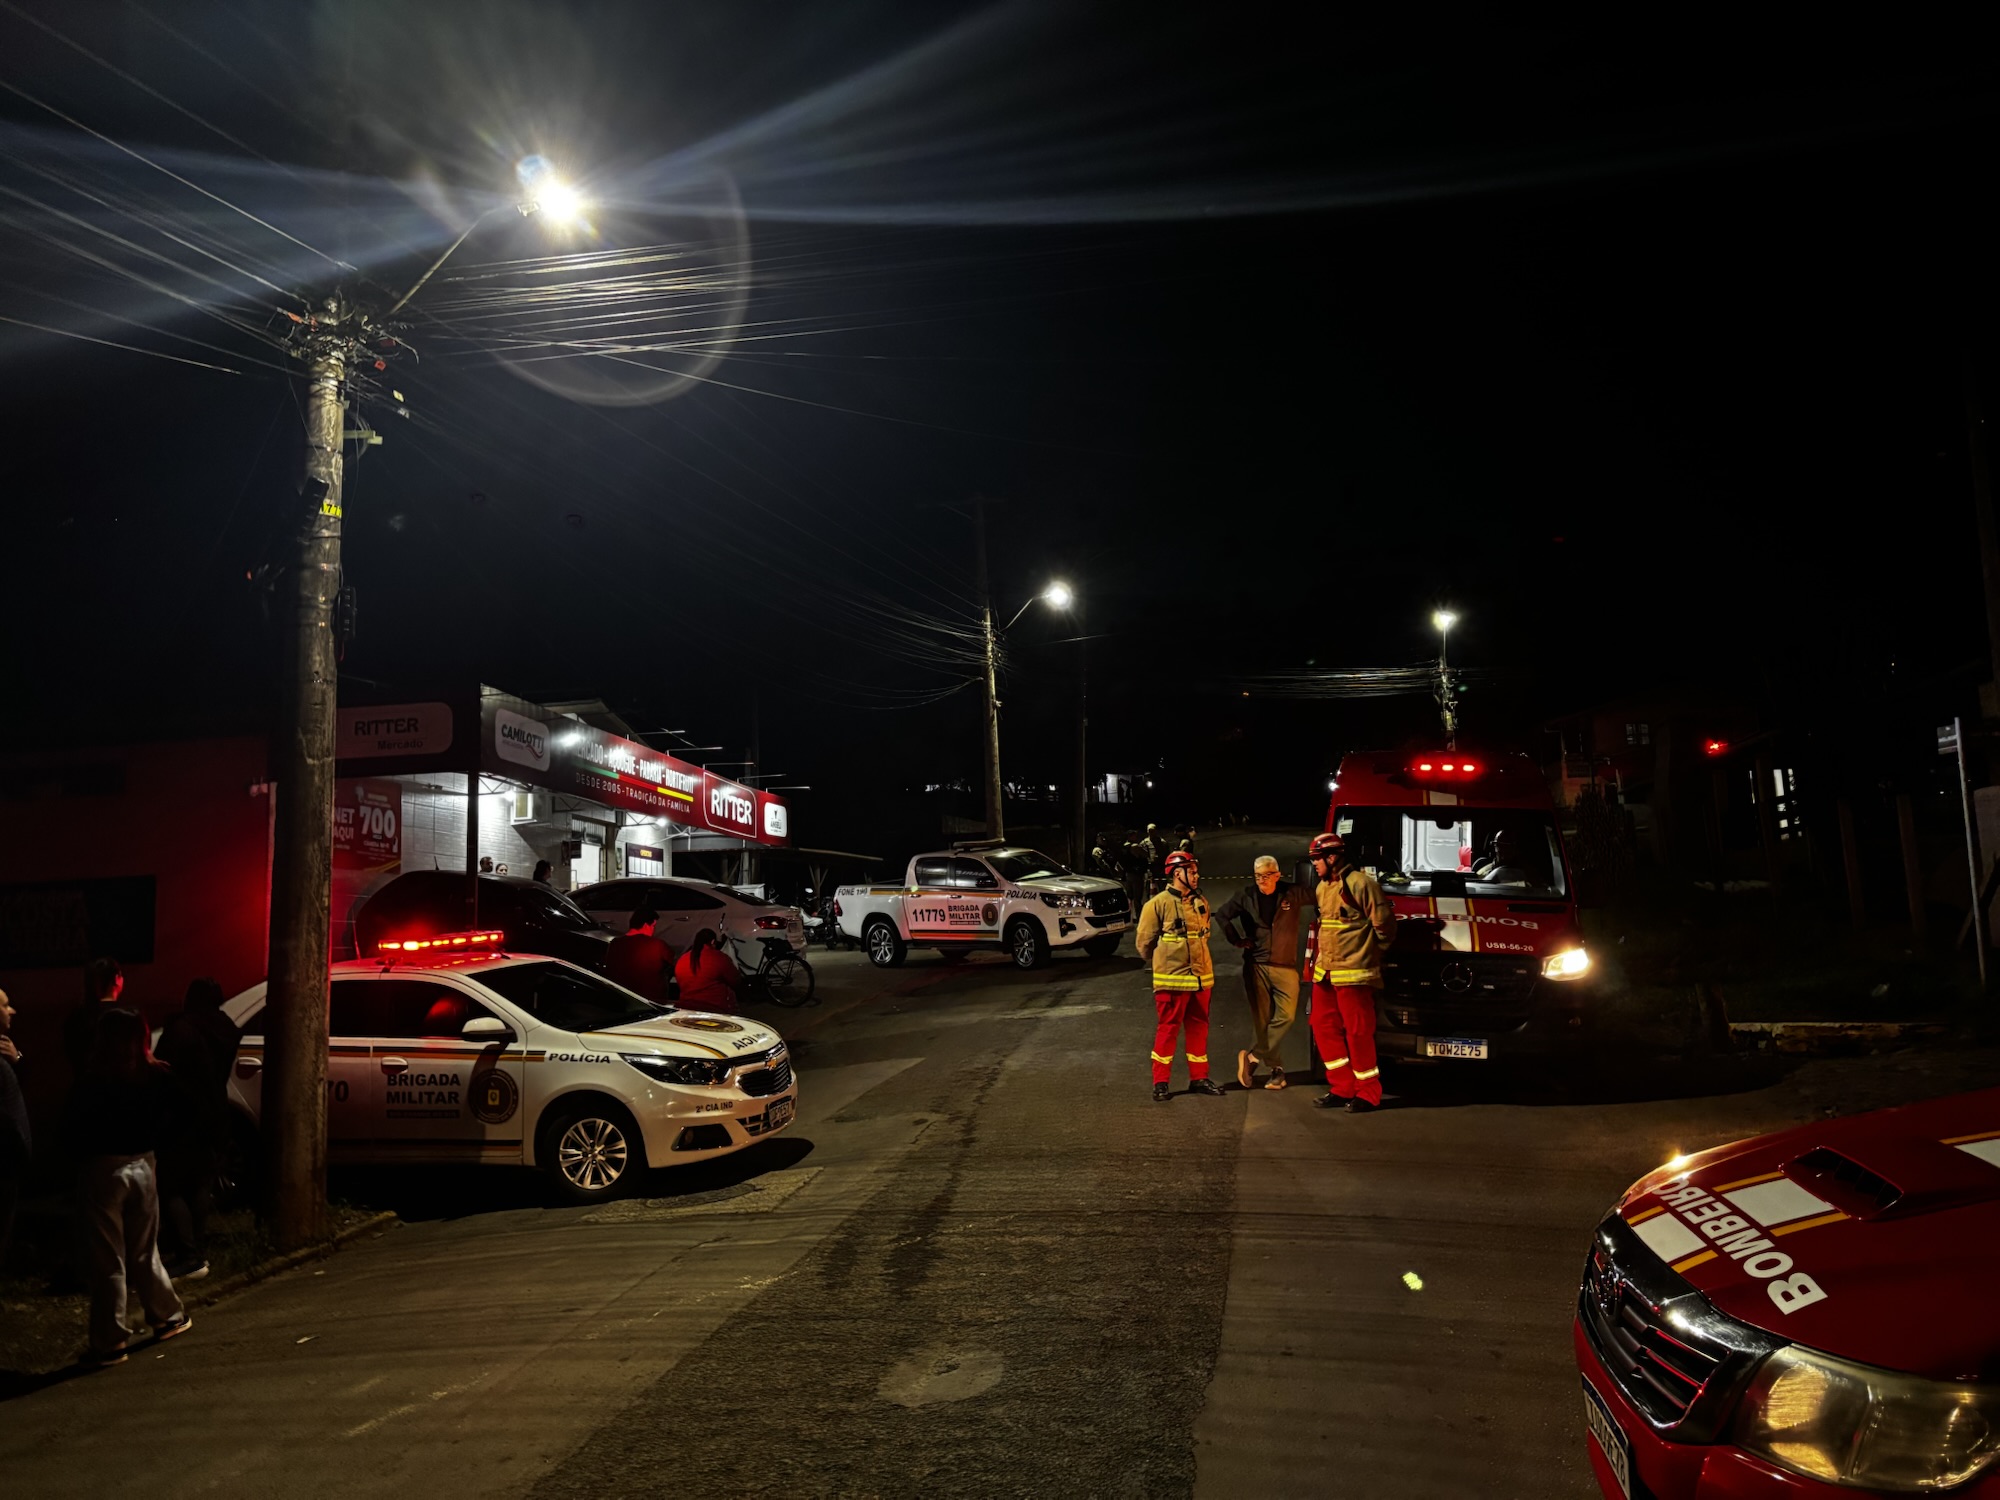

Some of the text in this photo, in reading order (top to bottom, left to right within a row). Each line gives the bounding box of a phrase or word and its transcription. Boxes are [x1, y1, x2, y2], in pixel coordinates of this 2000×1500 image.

[354, 718, 418, 736] RITTER
[501, 724, 544, 751] CAMILOTTI
[377, 740, 424, 750] Mercado
[575, 772, 600, 788] DESDE
[602, 780, 621, 795] 2005
[625, 787, 657, 804] TRADIÇÃO
[658, 797, 666, 807] DA
[667, 799, 690, 813] FAMÍLIA
[711, 788, 752, 825] RITTER
[360, 805, 396, 838] 700
[838, 887, 855, 896] FONE
[1006, 890, 1037, 900] POLÍCIA
[948, 904, 980, 912] BRIGADA
[912, 909, 946, 922] 11779
[949, 912, 981, 920] MILITAR
[548, 1052, 611, 1064] POLÍCIA
[387, 1073, 461, 1087] BRIGADA
[386, 1091, 460, 1104] MILITAR
[705, 1103, 719, 1112] CIA
[720, 1101, 733, 1110] IND
